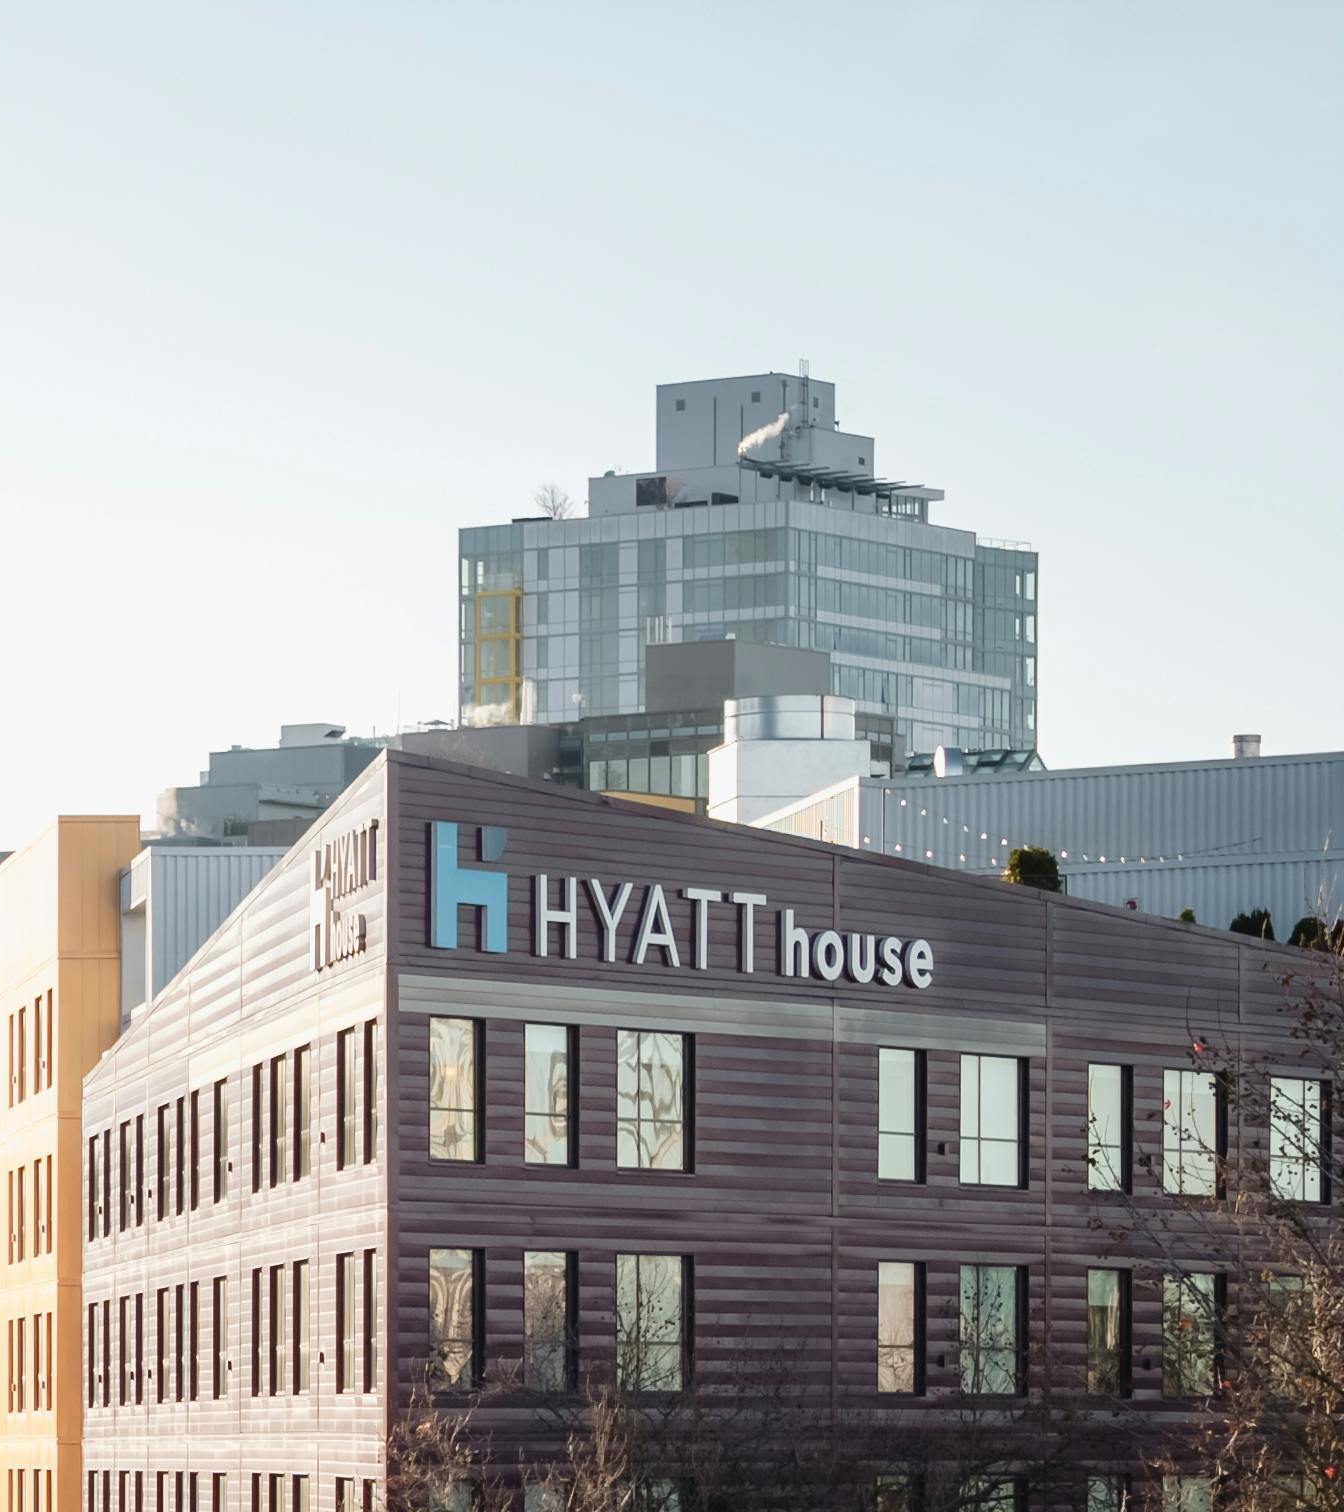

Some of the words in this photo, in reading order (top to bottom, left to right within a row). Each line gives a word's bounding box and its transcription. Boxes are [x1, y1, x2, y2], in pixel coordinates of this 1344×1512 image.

[330, 818, 379, 900] HYATT
[534, 873, 767, 973] HYATT
[780, 909, 934, 989] house
